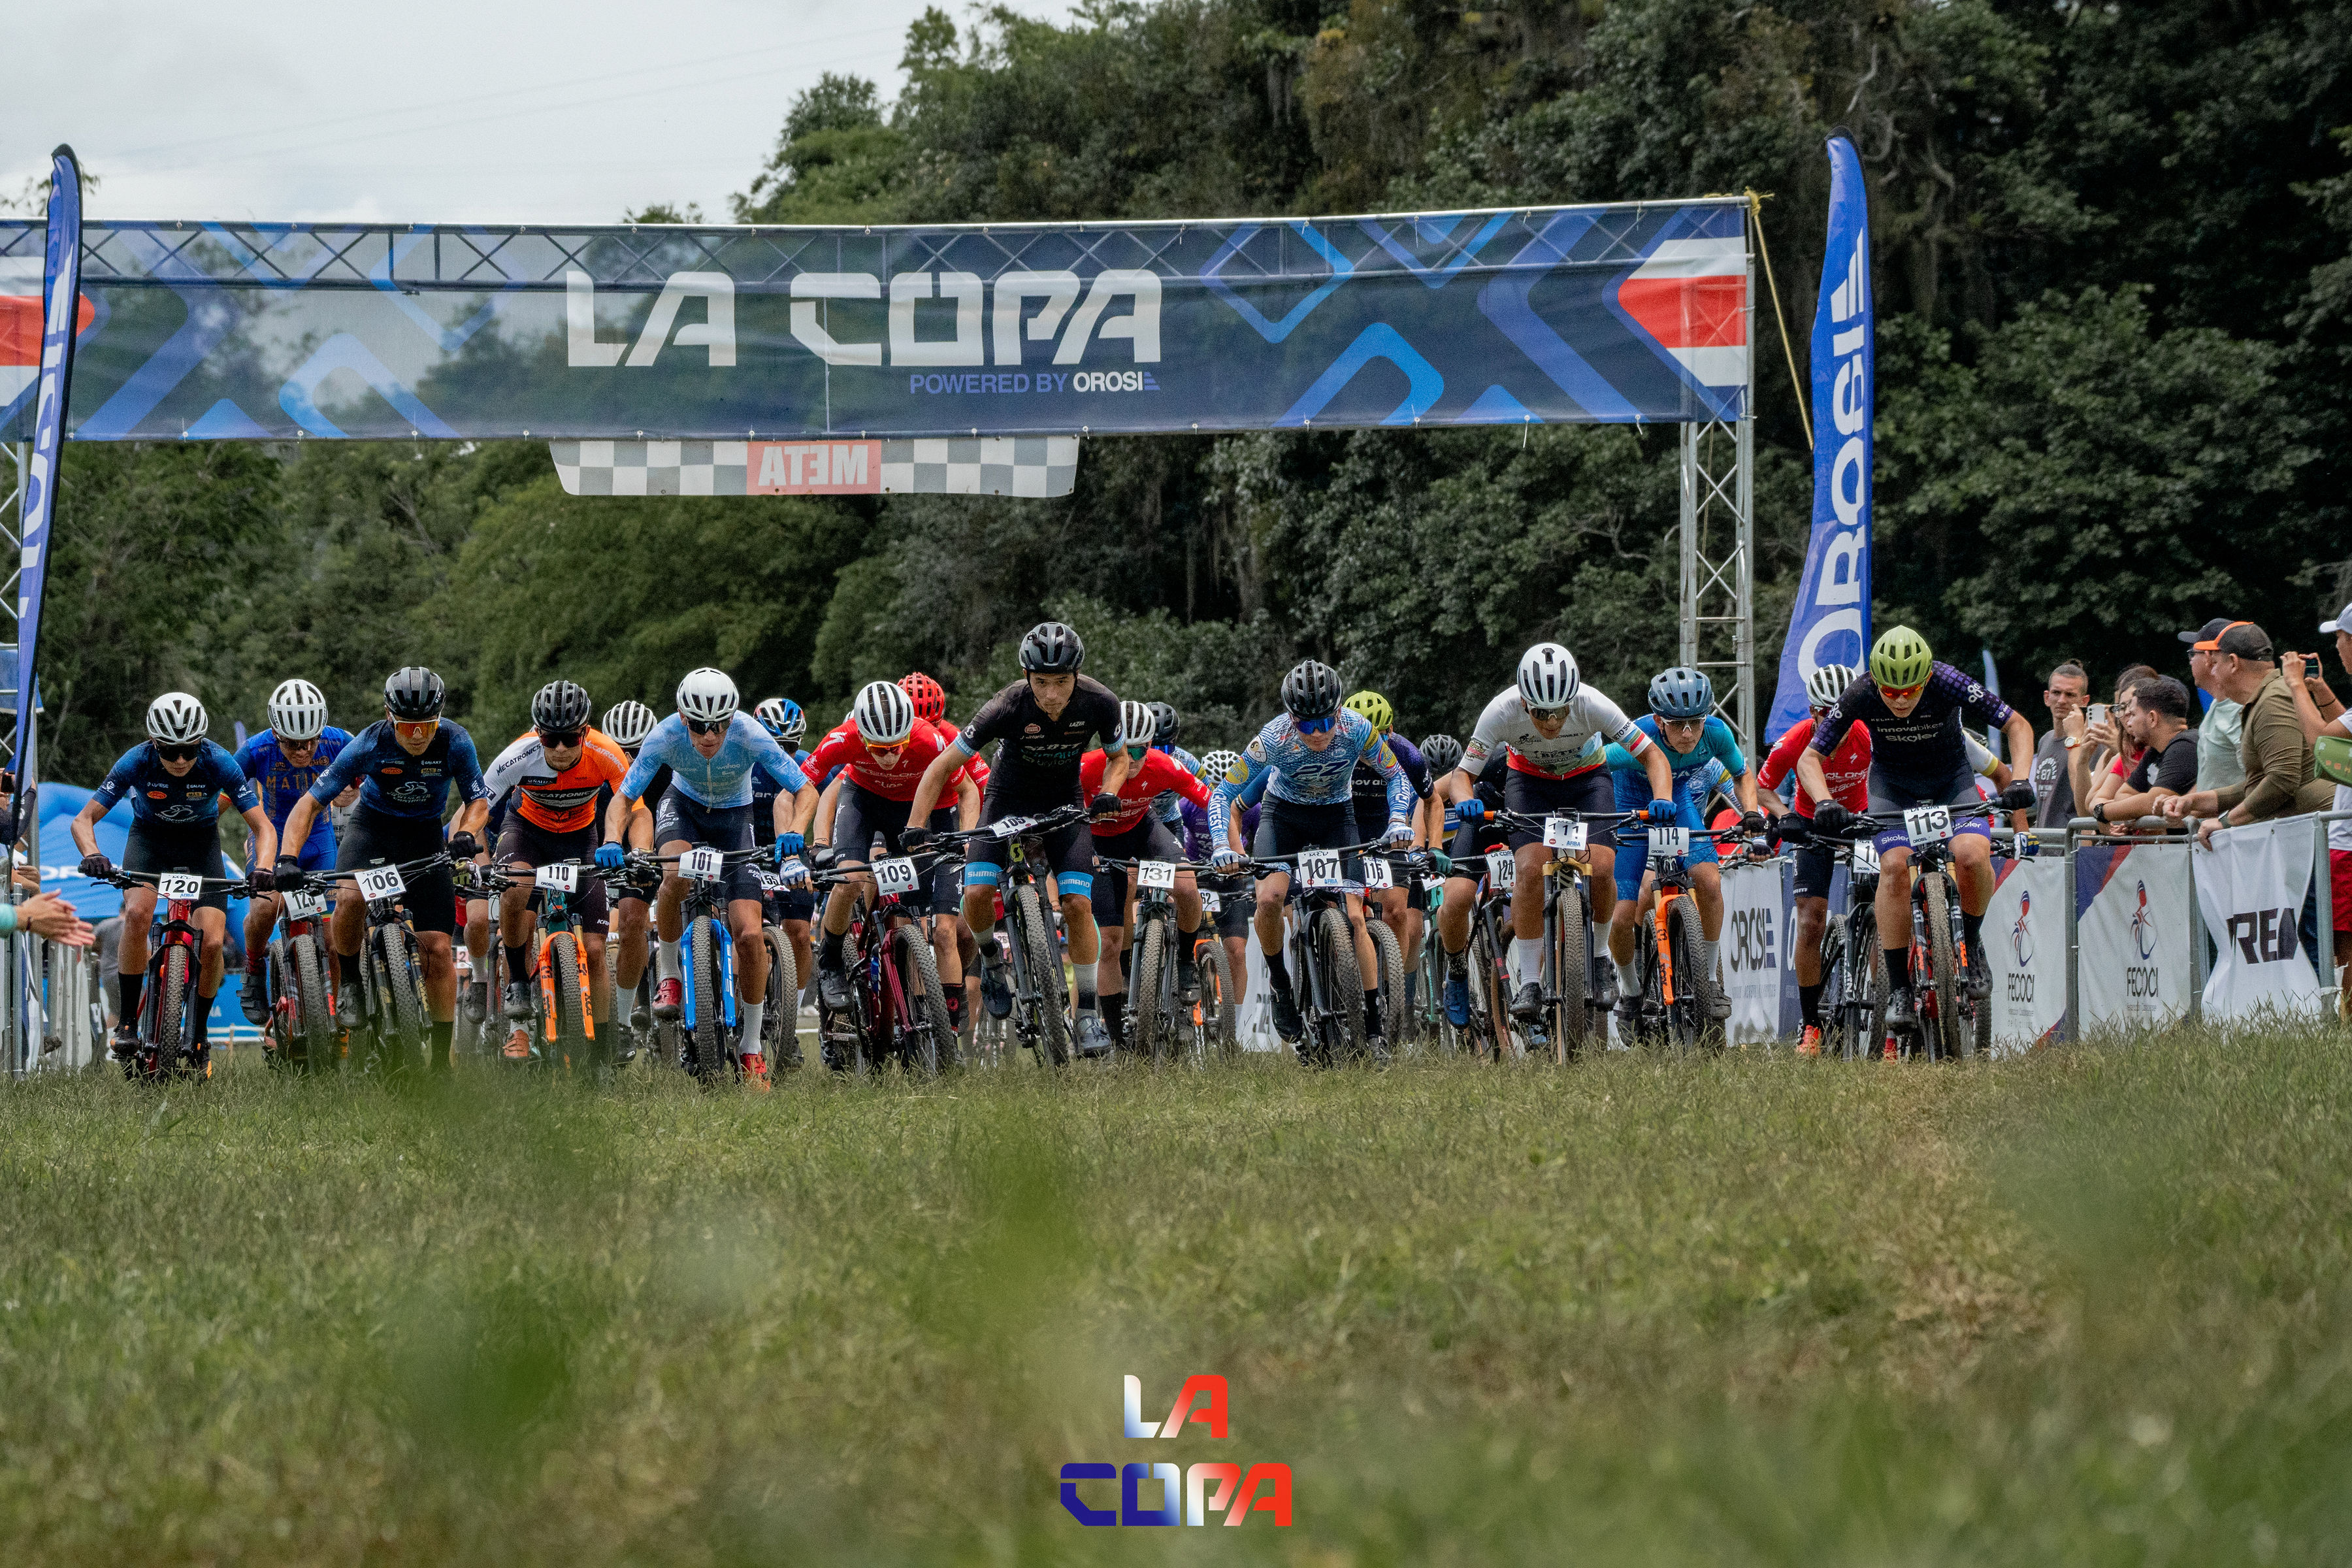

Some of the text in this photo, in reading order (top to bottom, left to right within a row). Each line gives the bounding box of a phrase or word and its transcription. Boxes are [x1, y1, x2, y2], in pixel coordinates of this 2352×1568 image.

[566, 269, 1161, 367] LA COPA
[909, 370, 1143, 394] POWERED BY OROSI
[496, 743, 542, 776] MECATRONICS
[1001, 816, 1026, 828] 105
[1548, 823, 1579, 840] 111
[1908, 810, 1948, 836] 113
[1657, 828, 1679, 845] 114
[691, 851, 713, 872] 101
[1302, 858, 1339, 879] 107
[1364, 861, 1384, 880] 115
[1496, 859, 1514, 881] 124
[362, 871, 399, 891] 106
[547, 866, 569, 881] 110
[761, 874, 781, 885] 155
[875, 864, 912, 884] 109
[1141, 867, 1172, 883] 131
[161, 879, 199, 894] 120
[1059, 879, 1090, 889] SHIMANO
[2007, 972, 2035, 1004] FECOCI
[2127, 966, 2159, 998] FECOCI
